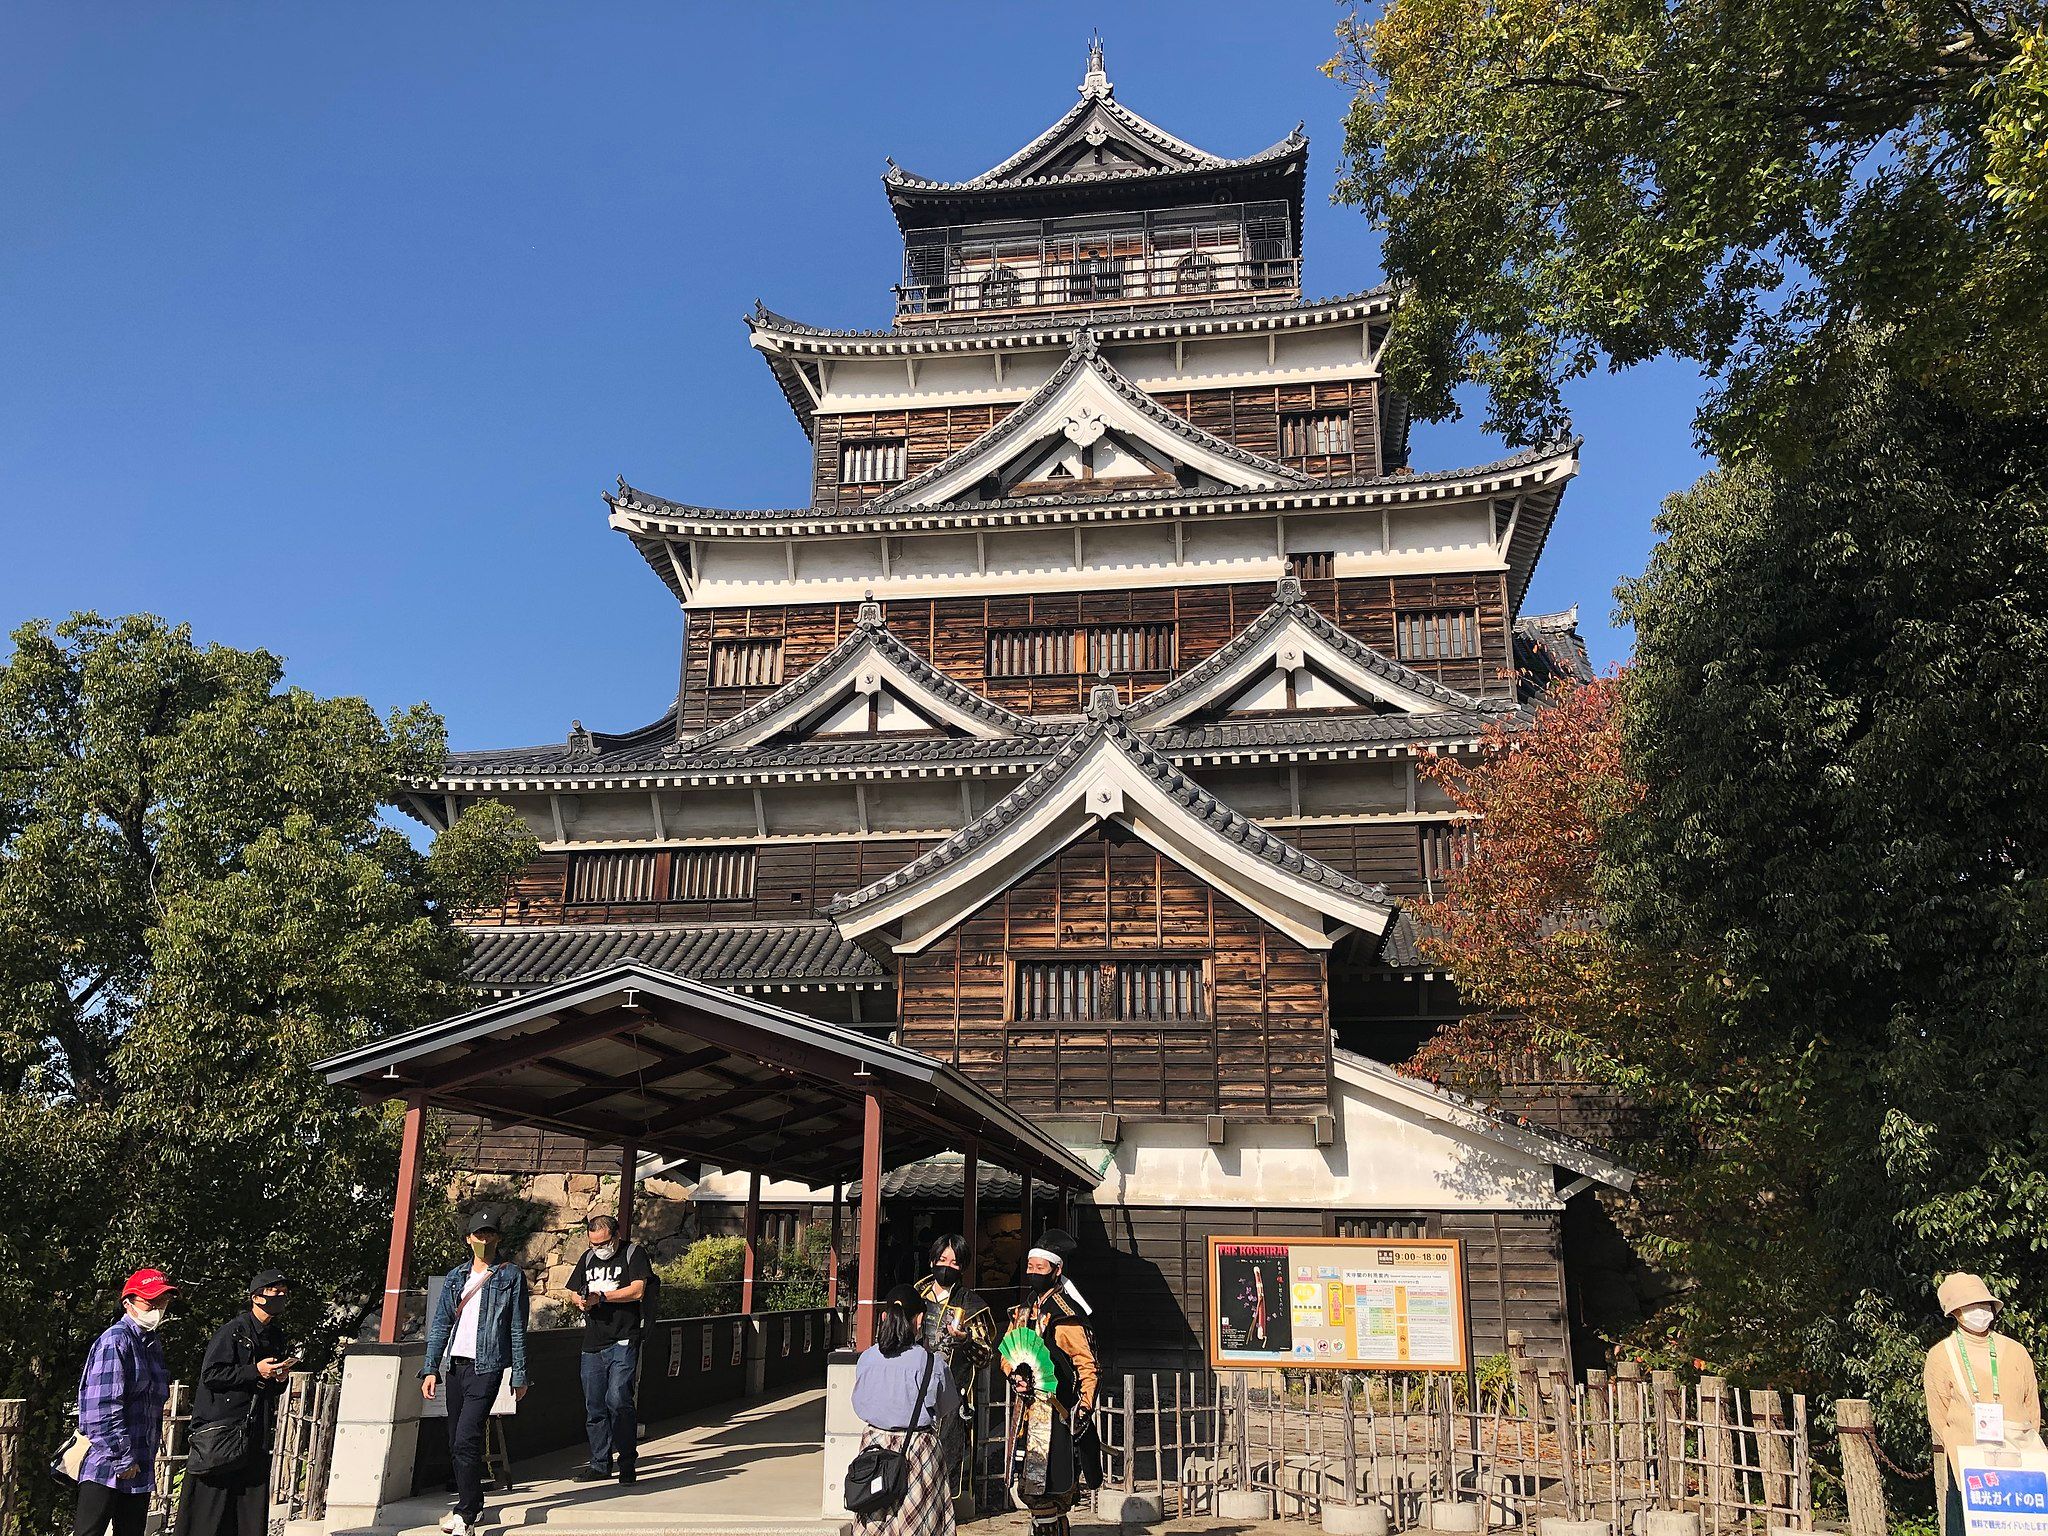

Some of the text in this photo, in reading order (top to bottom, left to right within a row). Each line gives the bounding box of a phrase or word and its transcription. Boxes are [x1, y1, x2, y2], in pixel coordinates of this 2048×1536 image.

[1218, 1246, 1289, 1256] THE KOSHIRAE
[1967, 1472, 1999, 1490] 無料
[1970, 1490, 2045, 1508] 観光ガイドの日
